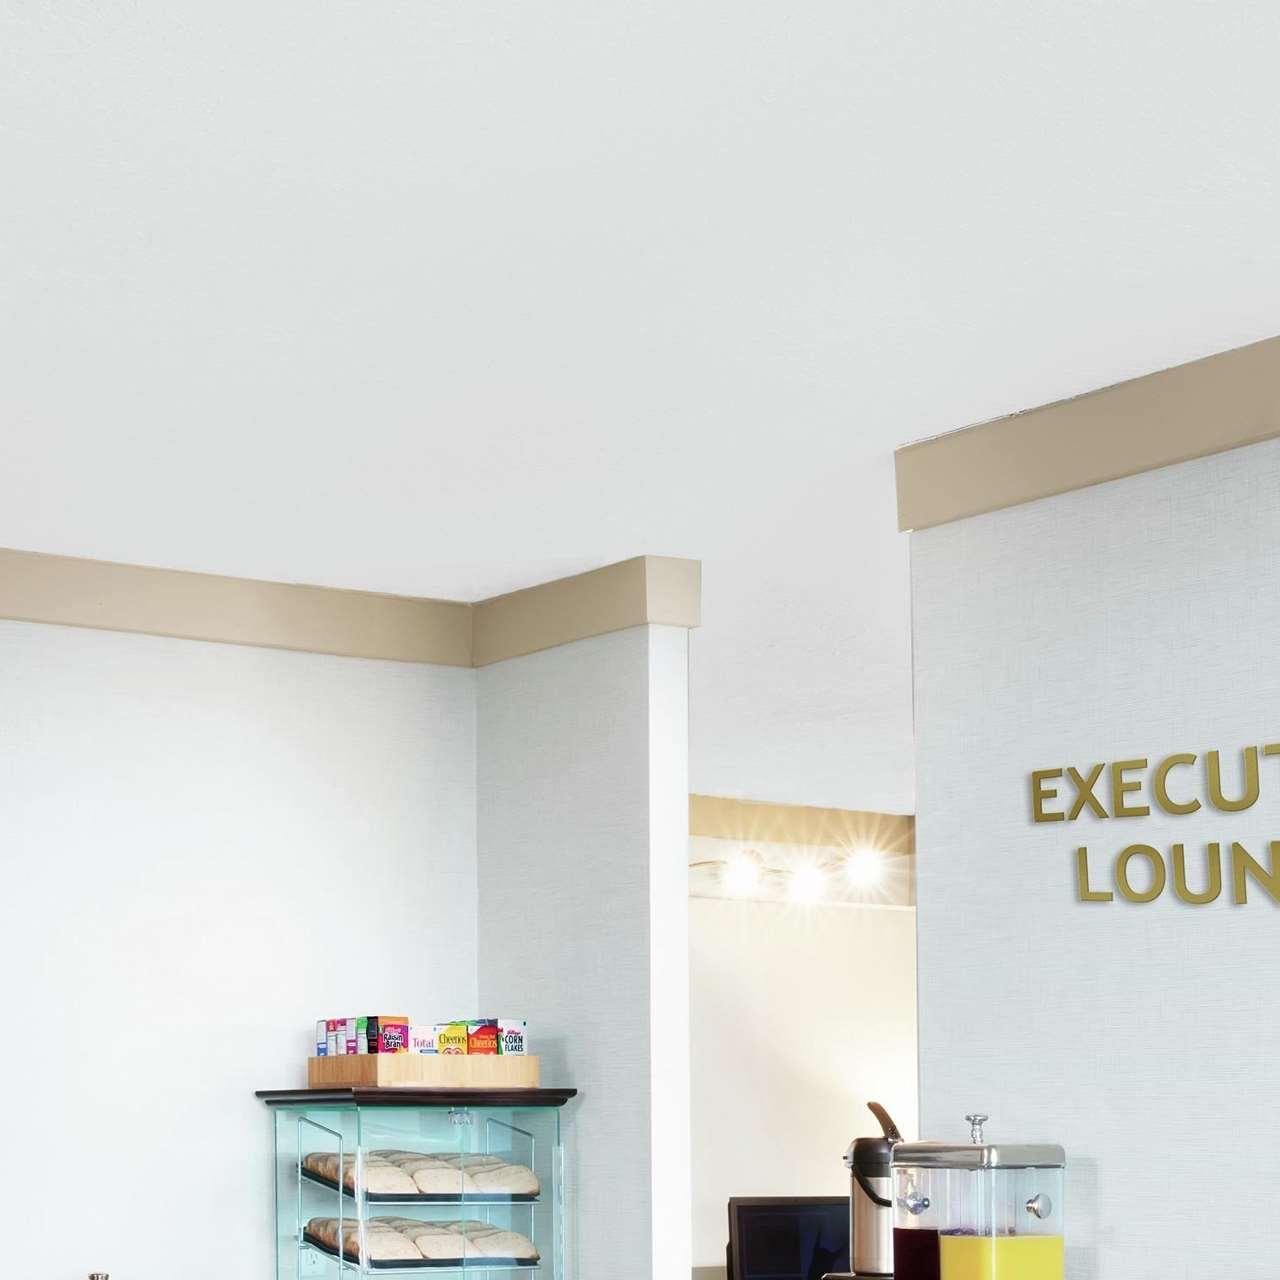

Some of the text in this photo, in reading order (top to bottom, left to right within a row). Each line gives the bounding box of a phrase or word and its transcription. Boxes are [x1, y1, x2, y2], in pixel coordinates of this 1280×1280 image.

[383, 1033, 403, 1042] Raisin
[439, 1034, 466, 1044] Cheerios
[504, 1035, 523, 1044] CORN
[384, 1040, 400, 1049] Bran
[413, 1038, 434, 1047] Total
[504, 1044, 524, 1052] FLAKES
